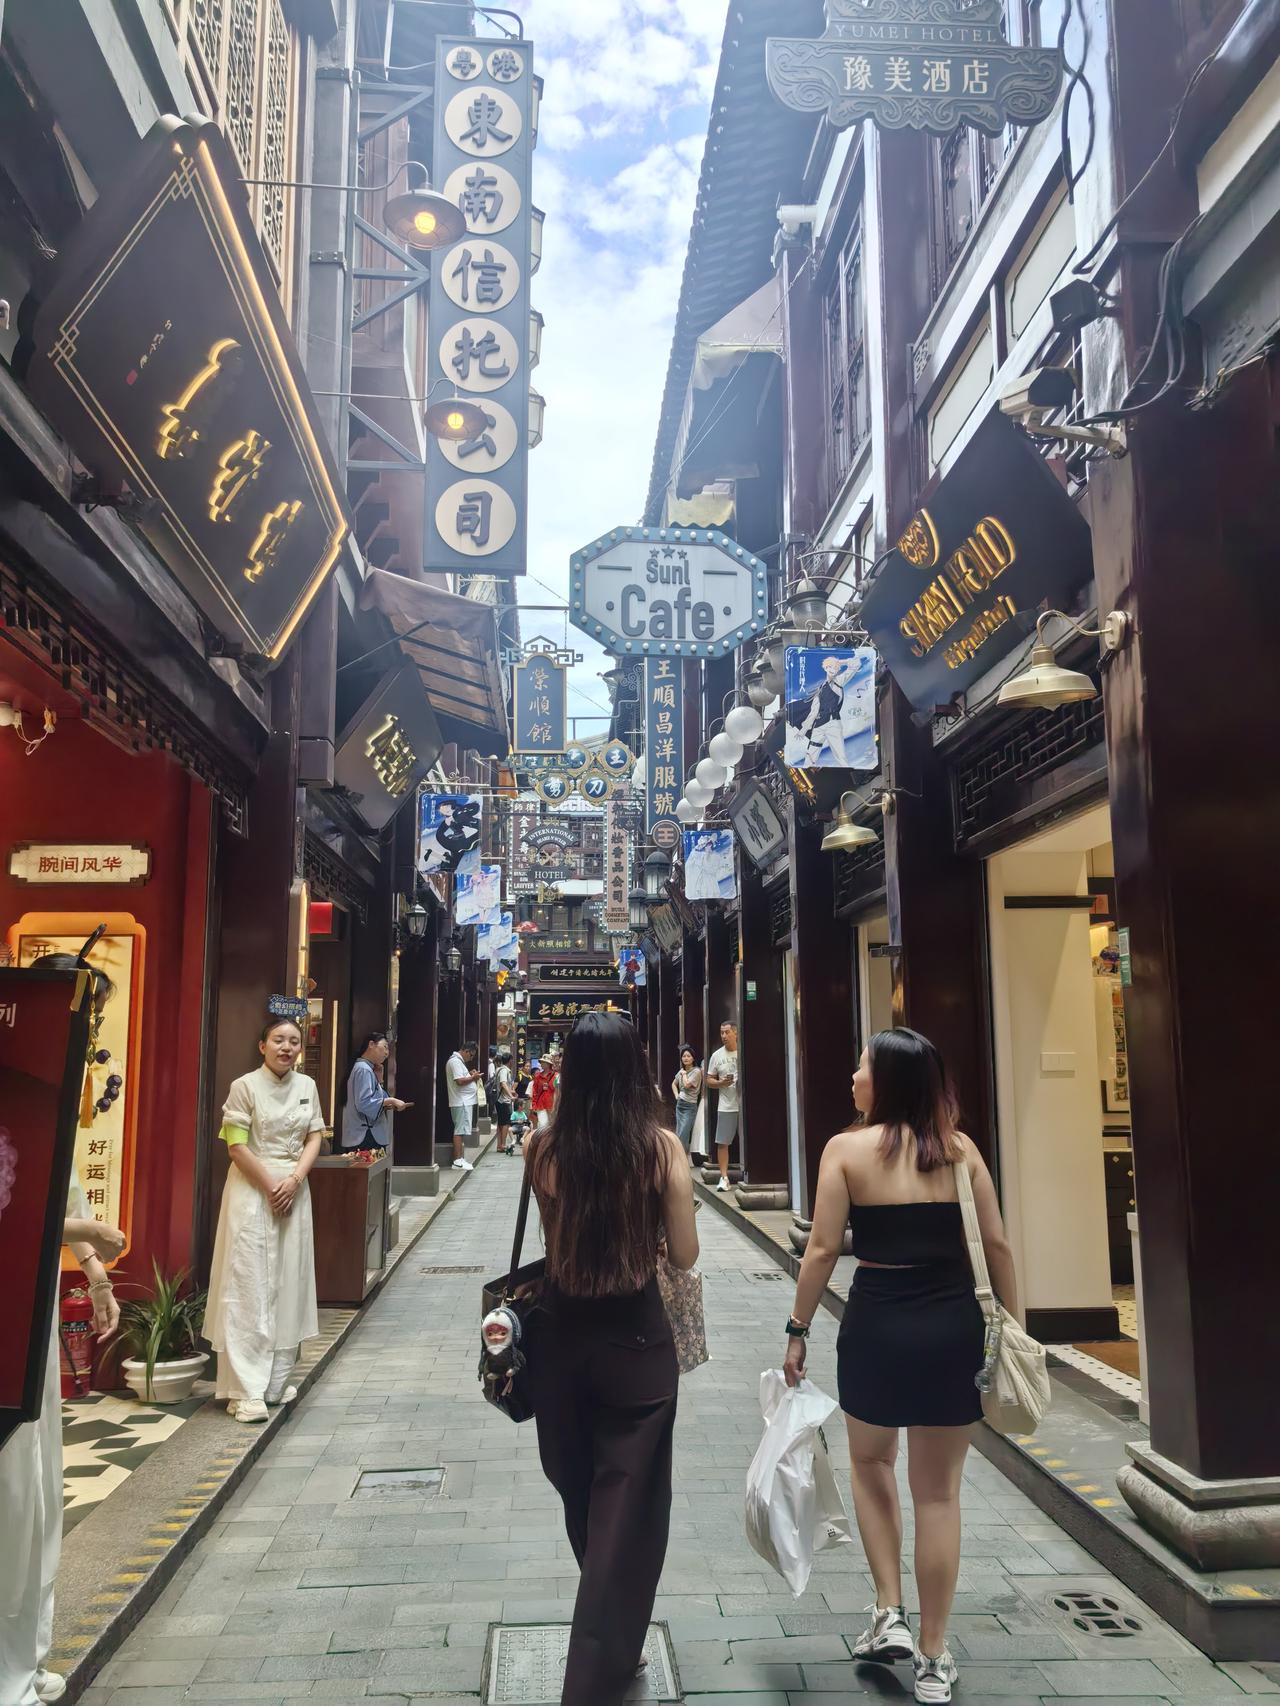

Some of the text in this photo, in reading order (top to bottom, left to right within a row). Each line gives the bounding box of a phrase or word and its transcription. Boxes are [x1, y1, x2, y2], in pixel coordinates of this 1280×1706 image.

[835, 24, 997, 43] YUMEI HOTEL
[842, 55, 990, 95] 豫美酒店
[620, 583, 715, 640] Cafe
[652, 659, 678, 816] 王順昌洋服號
[528, 828, 575, 842] INTERNATIONAL
[38, 856, 123, 873] 腕间风华
[534, 870, 567, 879] HOTEL
